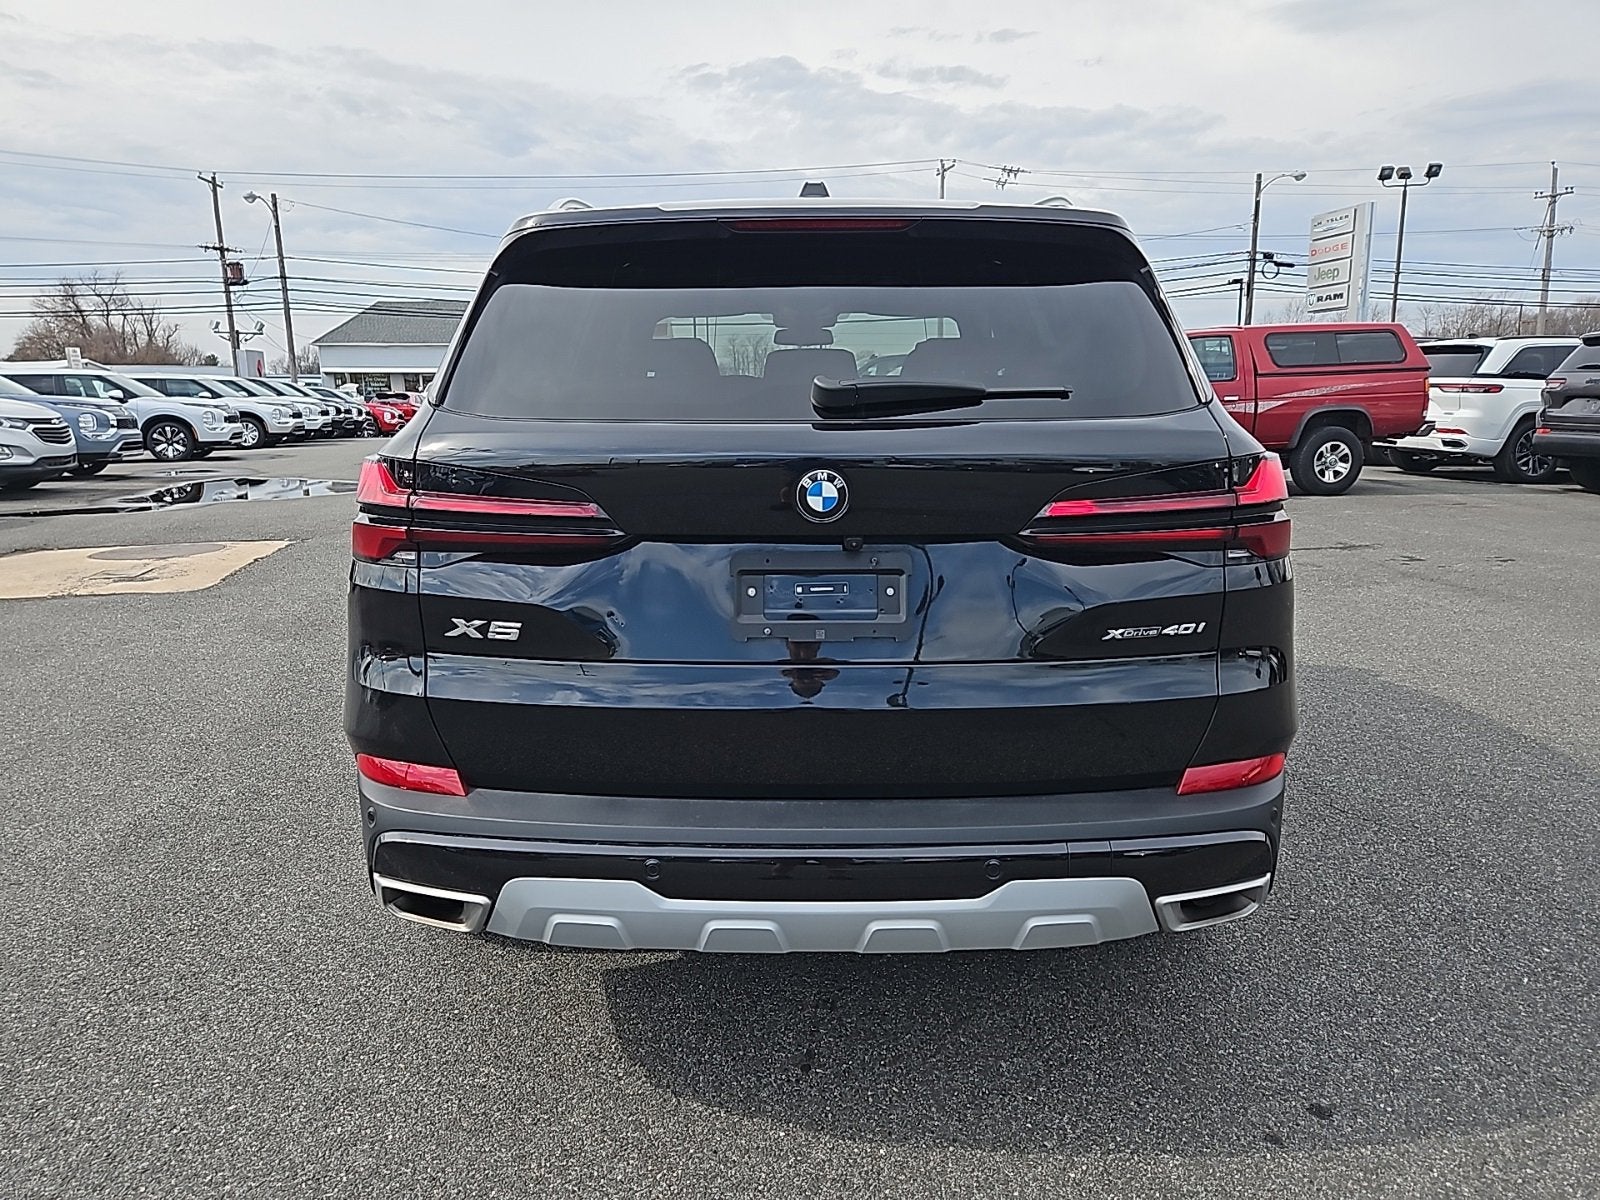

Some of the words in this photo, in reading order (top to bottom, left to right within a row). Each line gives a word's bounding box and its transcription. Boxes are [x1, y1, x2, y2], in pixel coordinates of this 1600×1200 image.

[1310, 242, 1348, 256] DODGE
[1314, 267, 1340, 281] Jeep
[1316, 292, 1344, 303] RAM
[802, 472, 844, 489] BMW
[443, 617, 523, 641] X5
